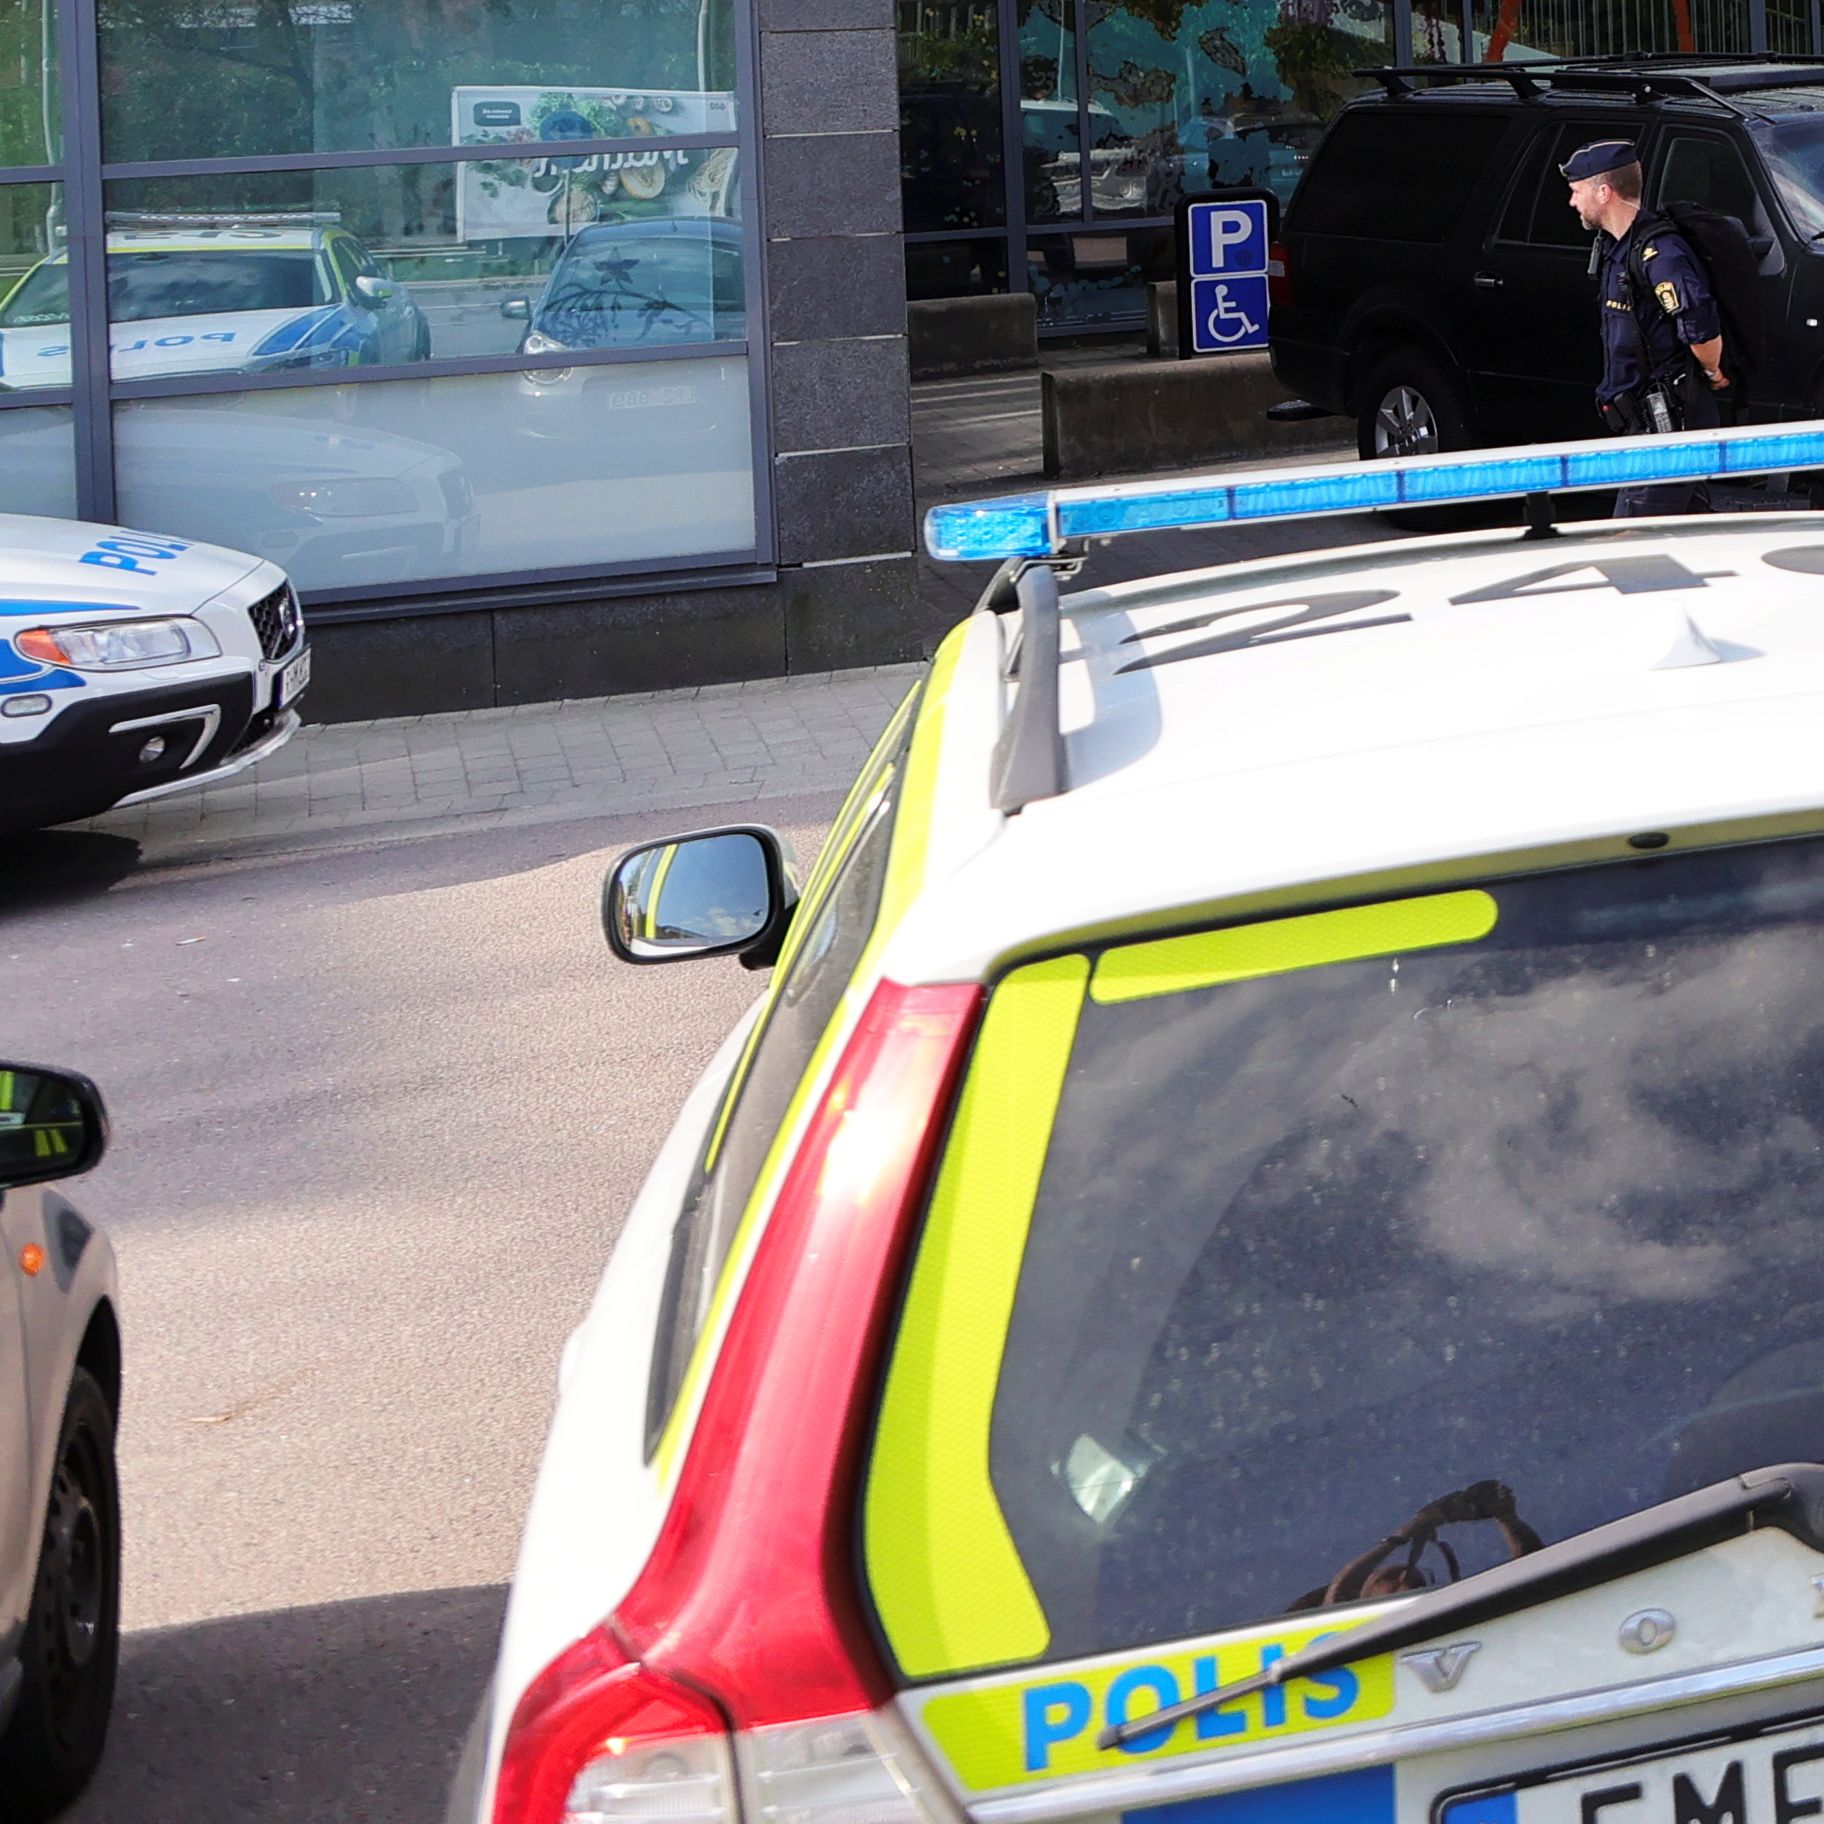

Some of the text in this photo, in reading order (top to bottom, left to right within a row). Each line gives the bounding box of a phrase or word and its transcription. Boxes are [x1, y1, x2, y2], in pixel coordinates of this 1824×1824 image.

[1210, 209, 1253, 269] P
[79, 529, 194, 576] POLI
[1023, 1631, 1360, 1771] POLIS
